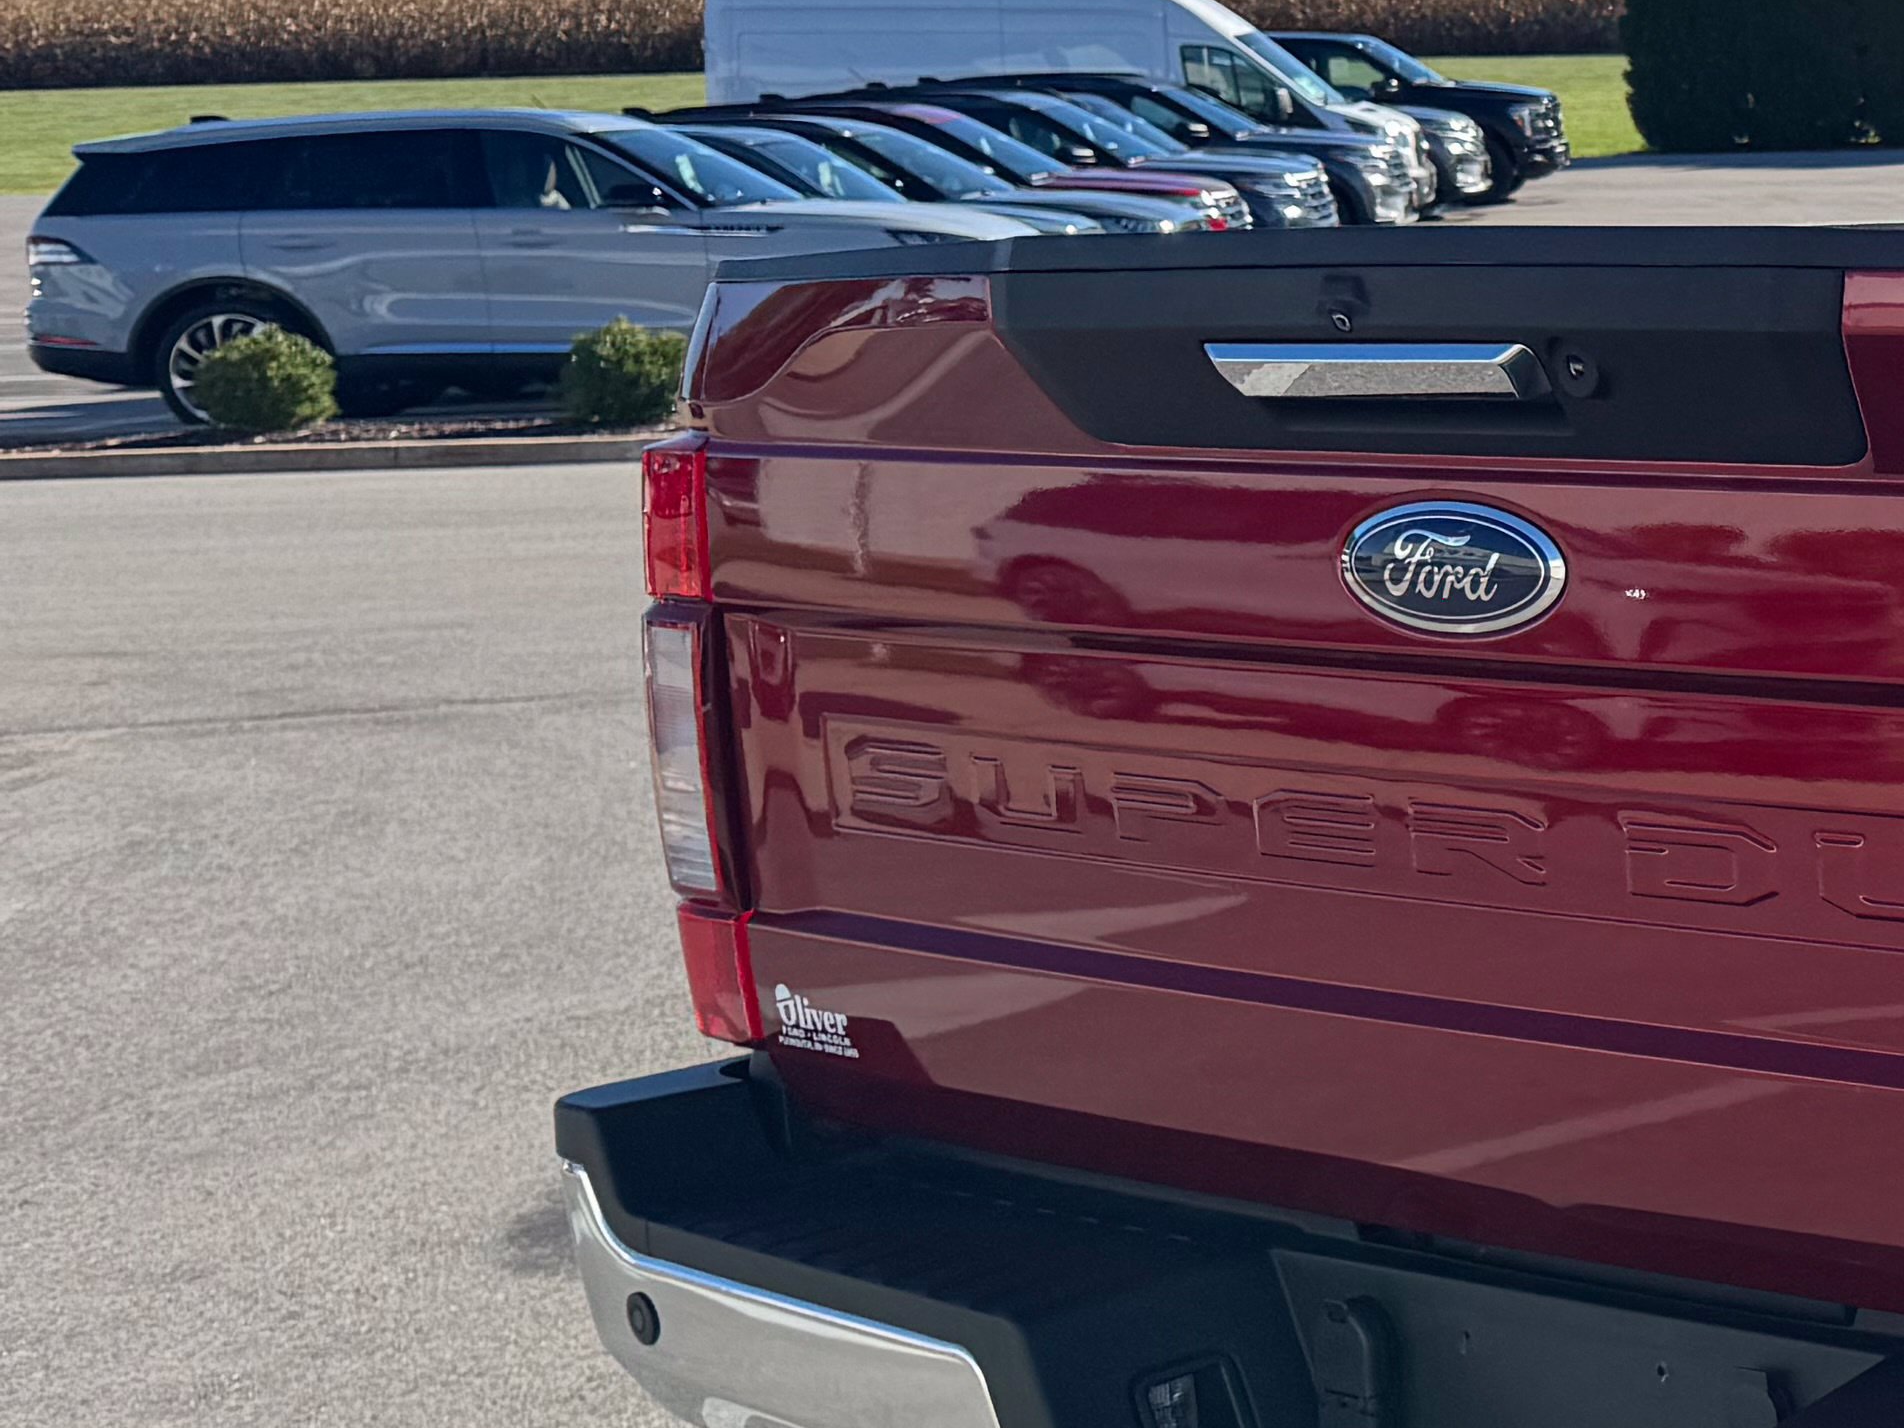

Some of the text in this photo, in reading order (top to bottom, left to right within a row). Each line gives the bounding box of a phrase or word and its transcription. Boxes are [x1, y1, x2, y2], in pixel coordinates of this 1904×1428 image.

[1384, 528, 1498, 603] Ford
[844, 733, 1548, 887] SUPER
[775, 983, 848, 1035] Oliver
